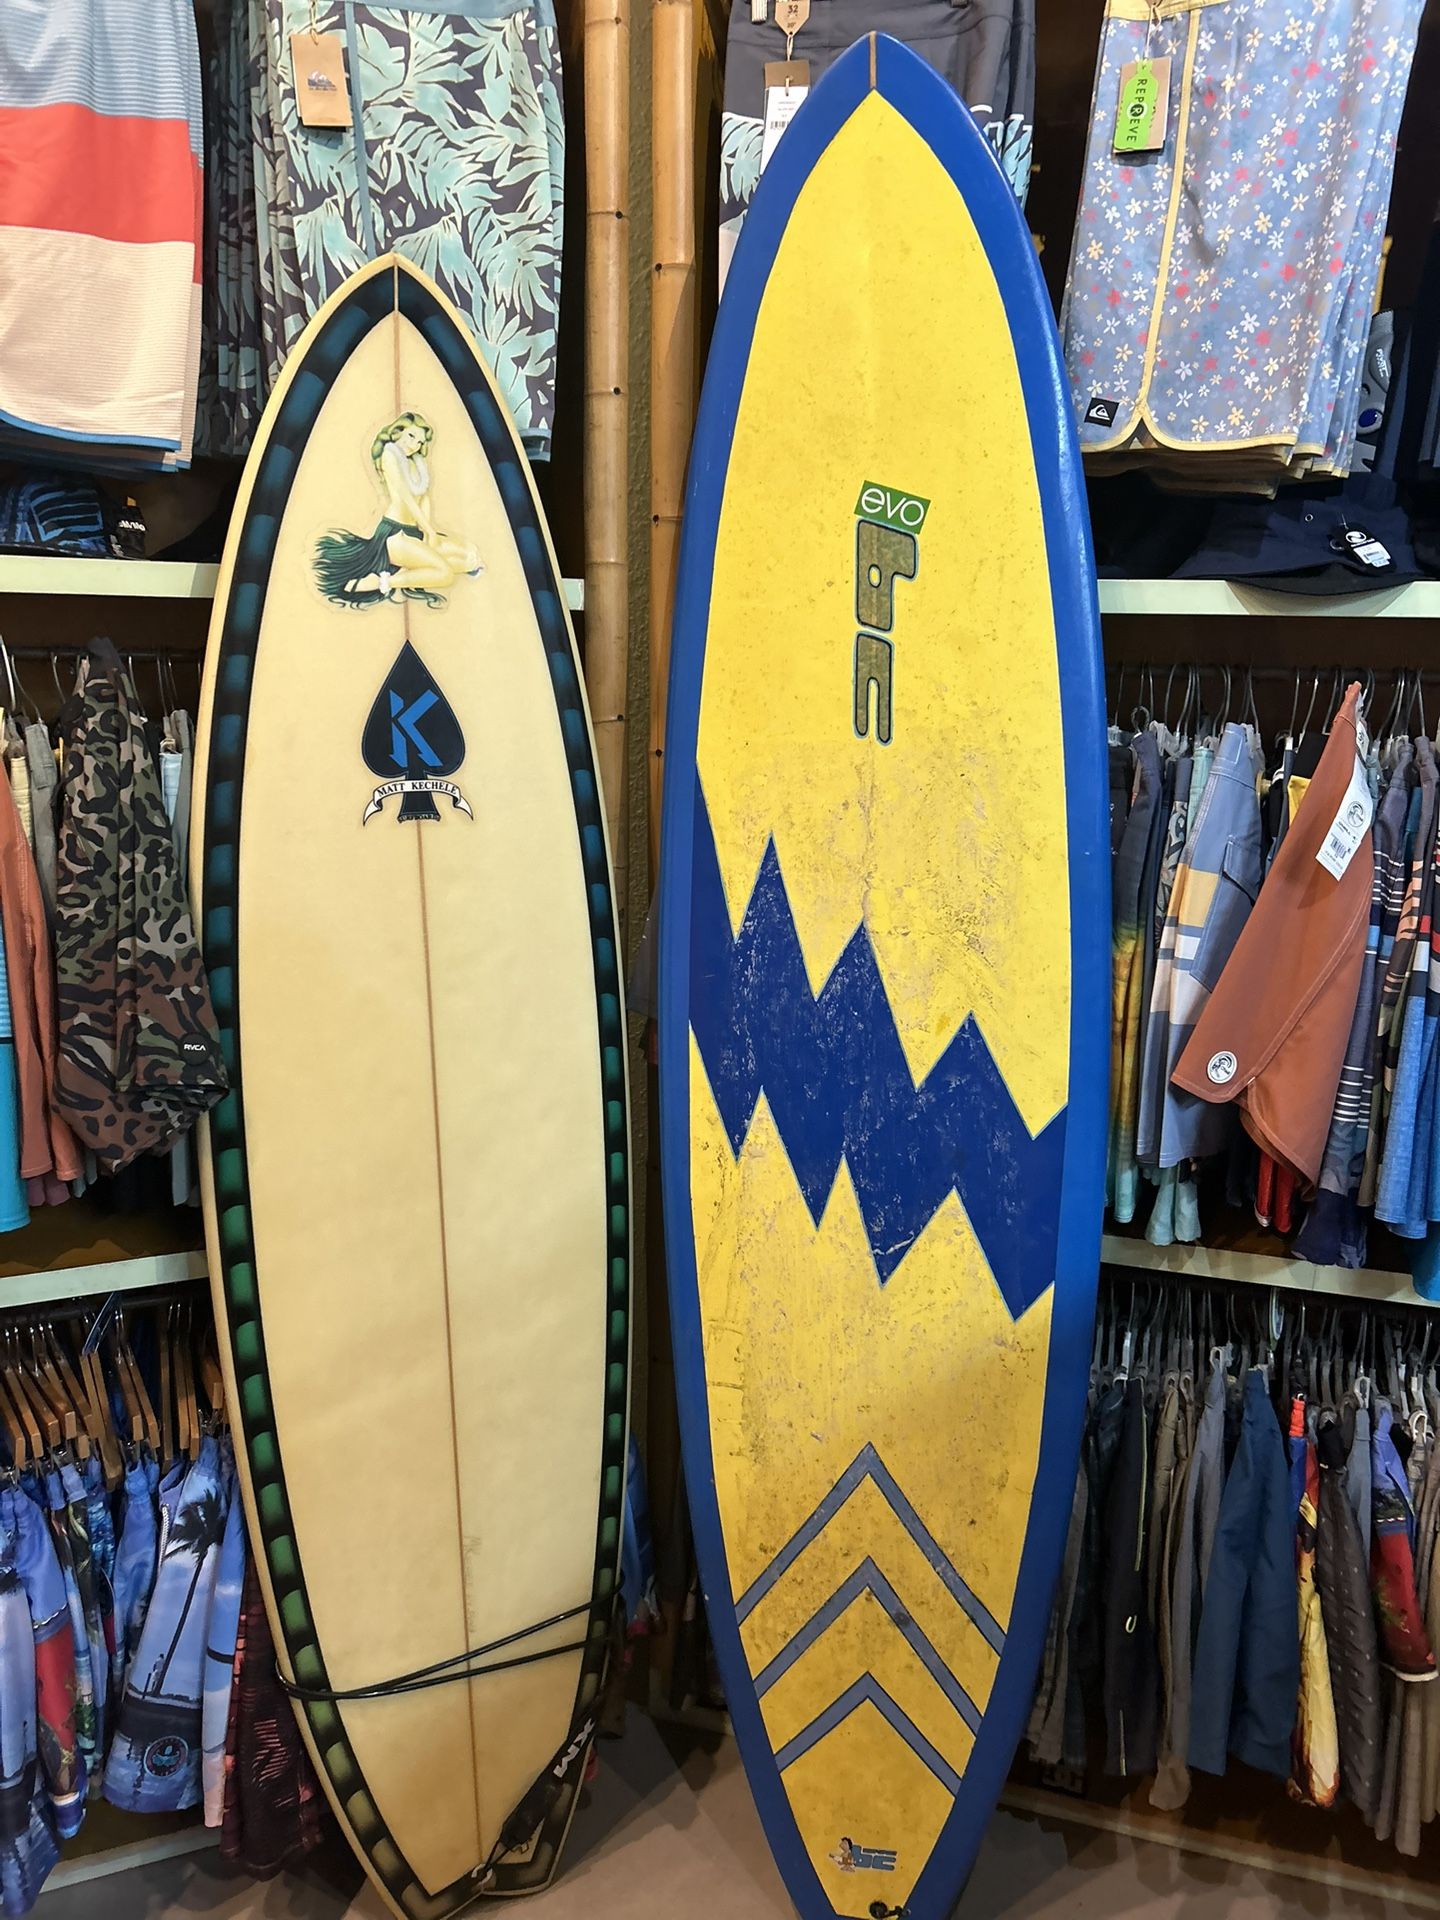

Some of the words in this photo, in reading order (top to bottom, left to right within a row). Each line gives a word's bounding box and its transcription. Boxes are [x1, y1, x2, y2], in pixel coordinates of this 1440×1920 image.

[1126, 79, 1148, 142] REPREVE
[861, 488, 924, 525] evo
[389, 690, 442, 767] K
[377, 783, 405, 796] MATT
[411, 781, 457, 794] KECHELE
